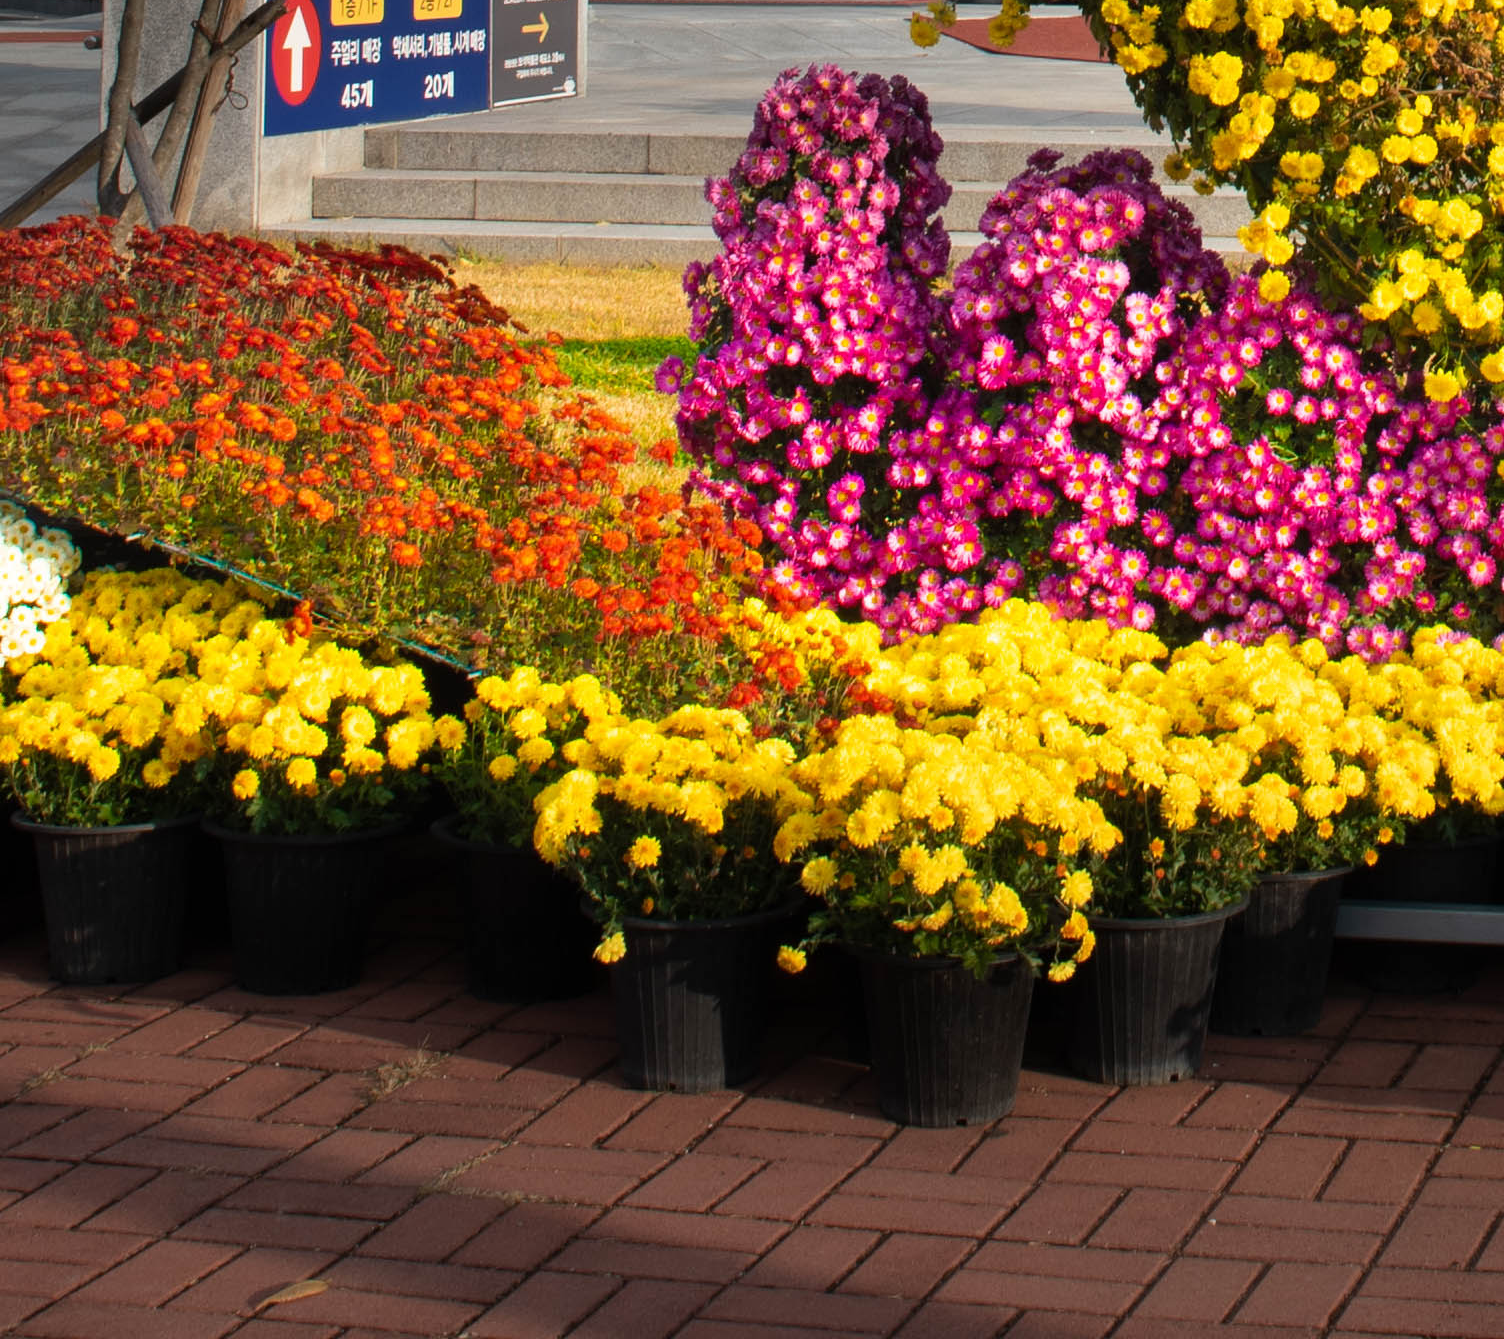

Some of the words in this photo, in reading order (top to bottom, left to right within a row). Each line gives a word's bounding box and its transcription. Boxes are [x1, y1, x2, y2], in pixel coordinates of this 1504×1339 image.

[330, 38, 360, 67] 주얼리
[362, 36, 382, 64] 매장
[341, 79, 374, 109] 45개
[423, 71, 455, 100] 20개
